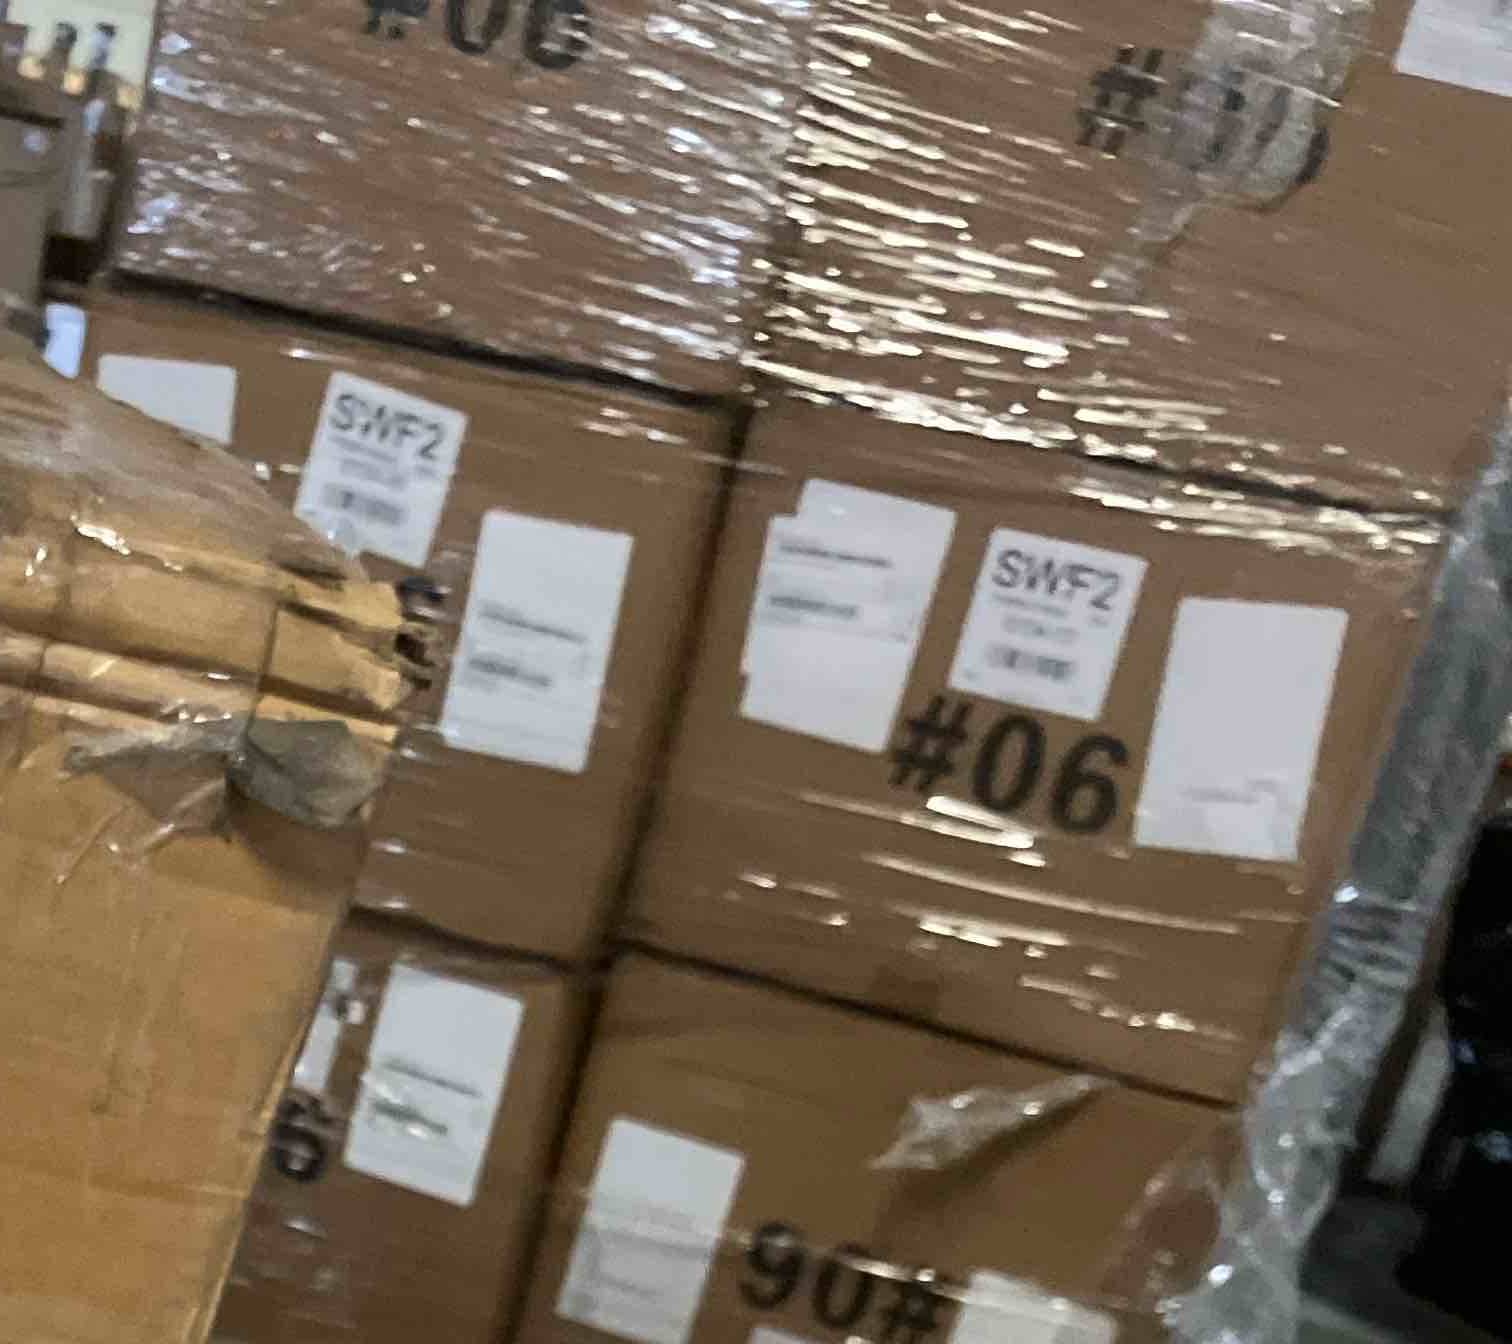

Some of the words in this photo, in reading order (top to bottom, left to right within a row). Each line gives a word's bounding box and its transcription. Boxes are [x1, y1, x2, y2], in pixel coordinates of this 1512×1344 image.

[330, 394, 445, 461] SWF2
[991, 549, 1120, 611] SWF2
[889, 696, 1129, 833] #06
